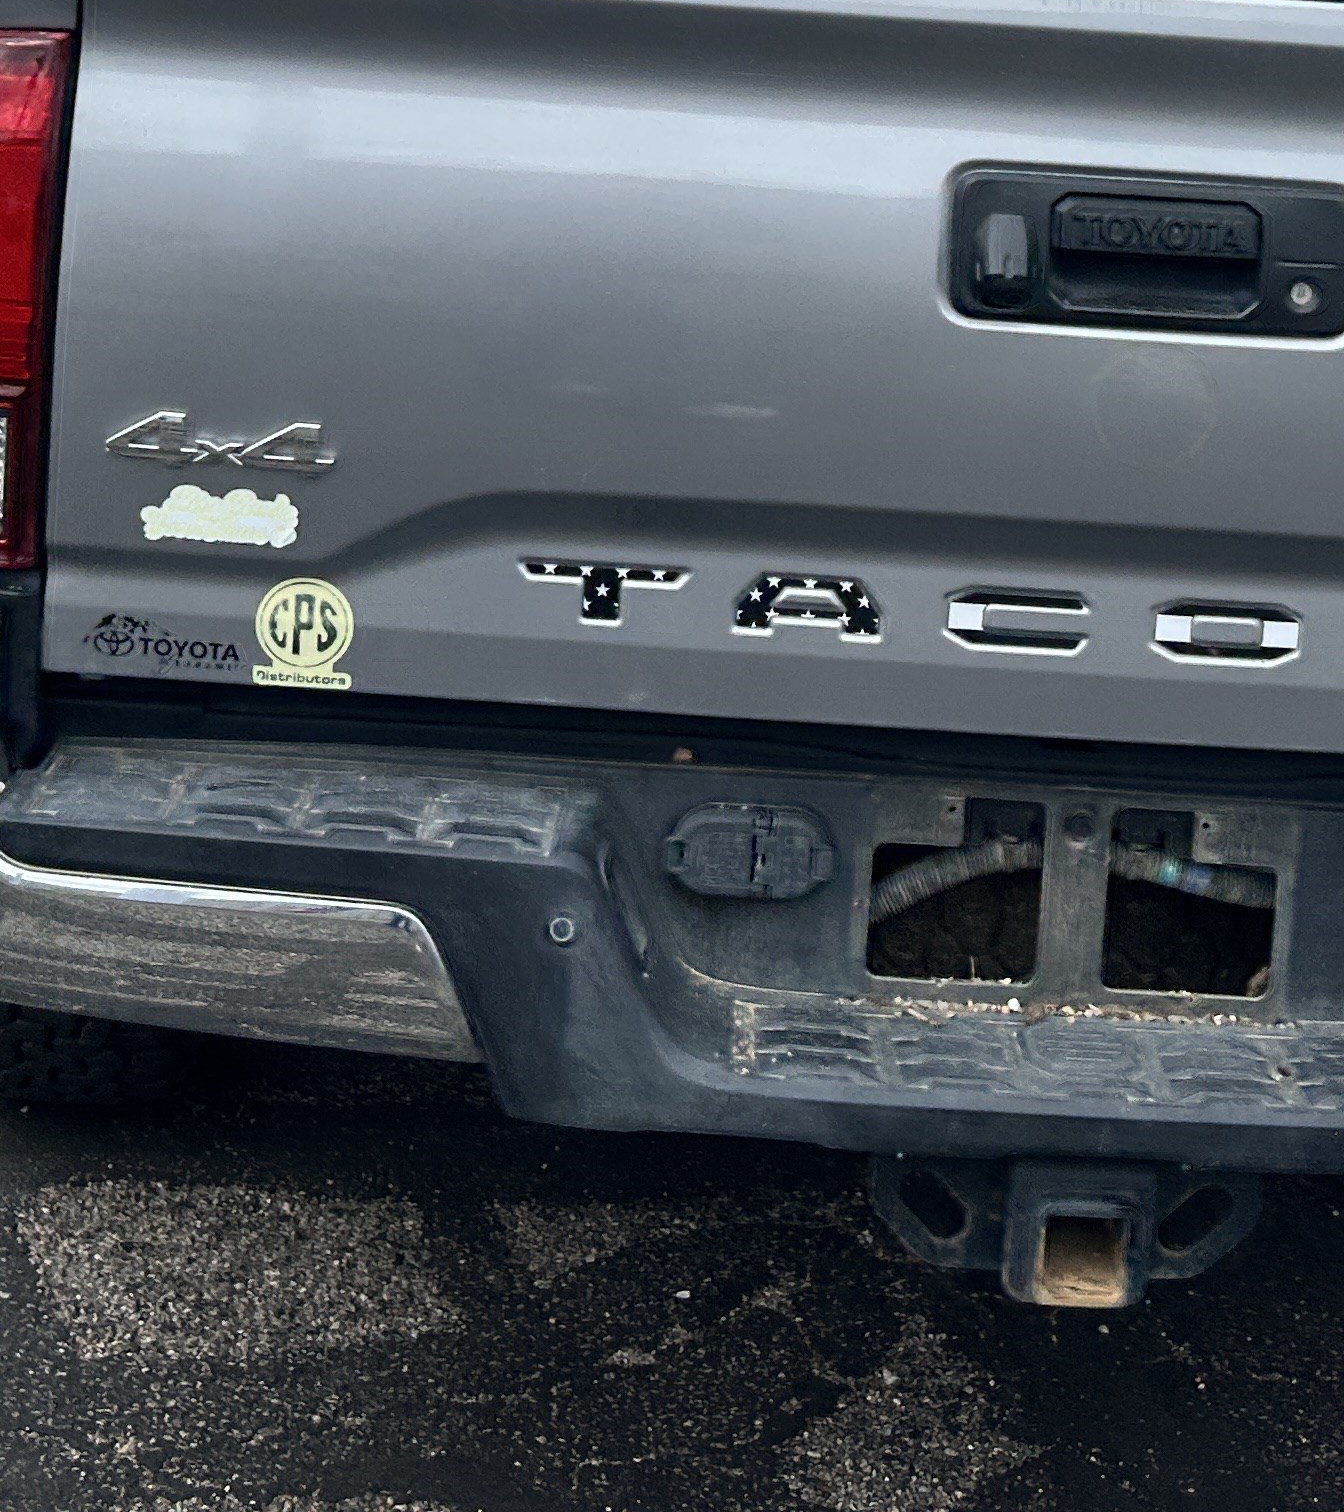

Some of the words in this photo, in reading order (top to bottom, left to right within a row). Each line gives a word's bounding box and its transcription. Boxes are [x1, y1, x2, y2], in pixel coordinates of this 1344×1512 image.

[1072, 212, 1254, 254] TOYOTA
[268, 593, 338, 656] CPS
[138, 636, 240, 663] TOYOTA
